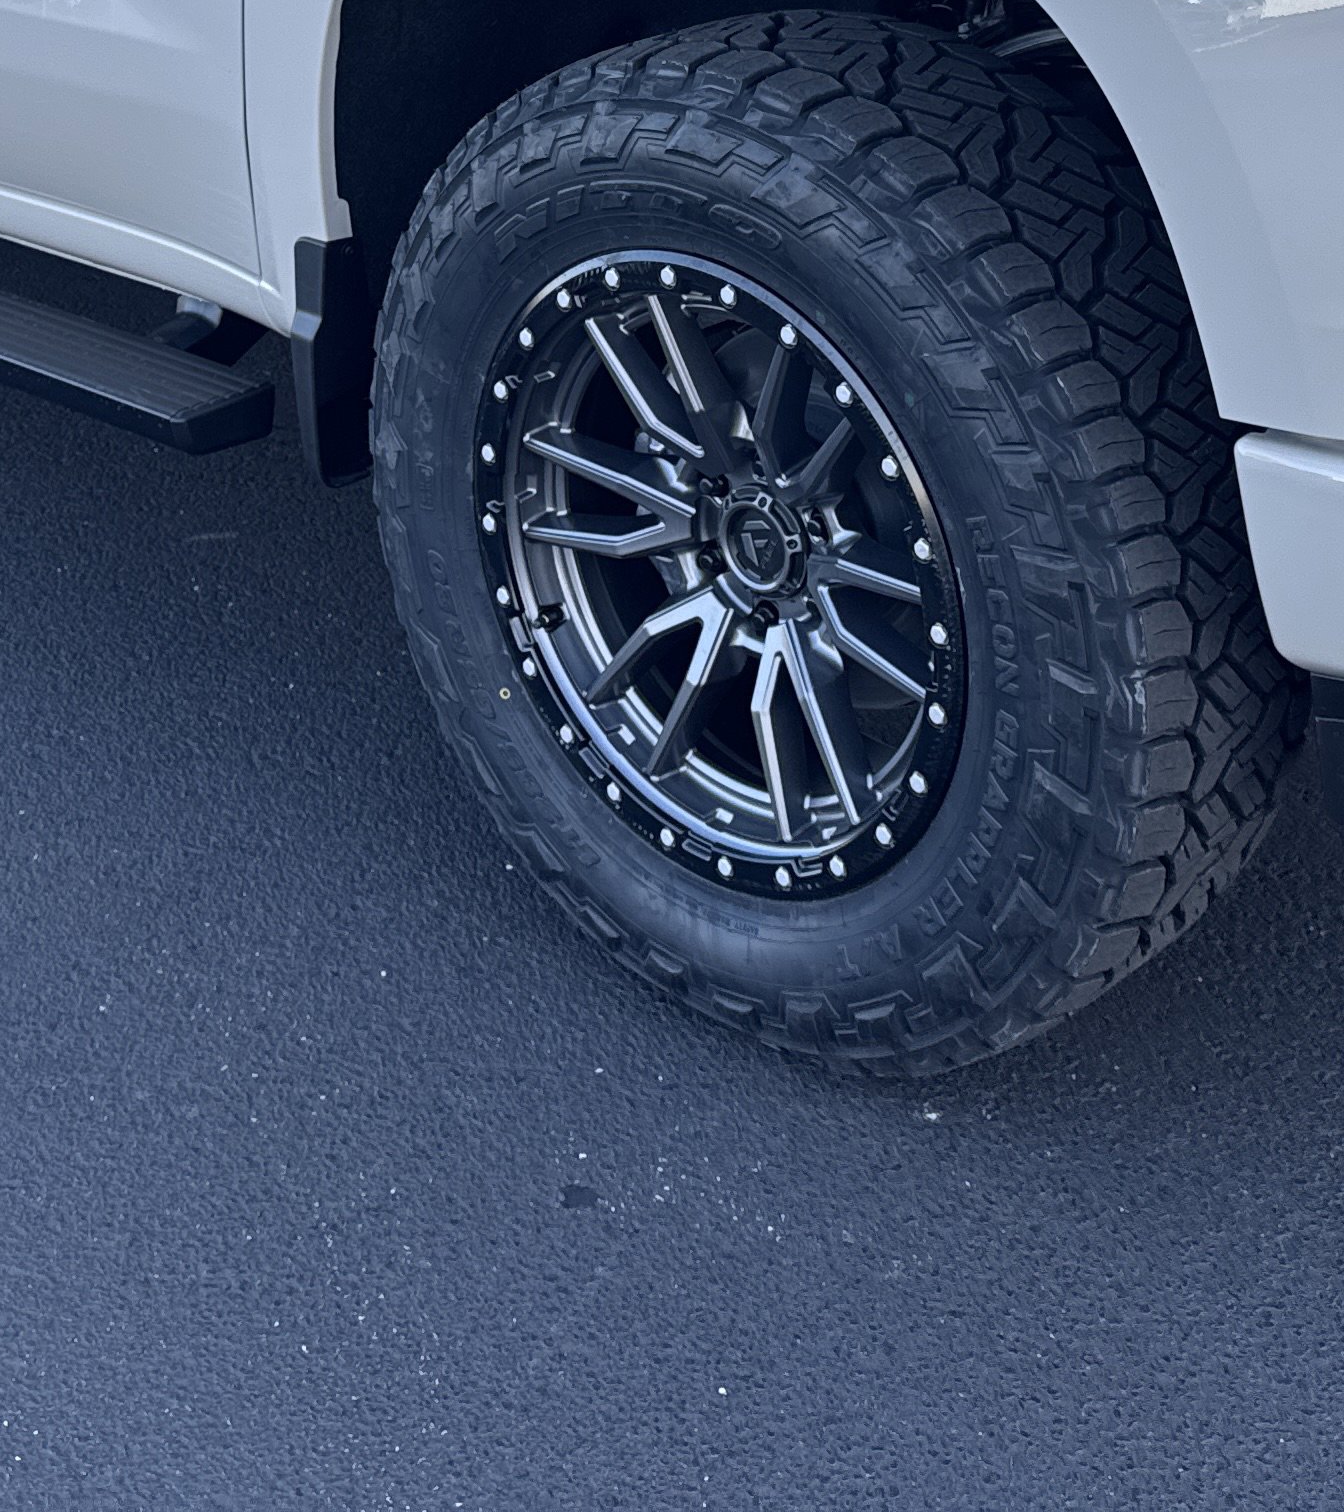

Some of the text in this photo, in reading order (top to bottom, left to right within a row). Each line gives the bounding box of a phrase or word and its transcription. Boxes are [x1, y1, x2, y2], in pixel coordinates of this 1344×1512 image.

[493, 179, 783, 265] NITTO
[964, 515, 1021, 697] RECON
[911, 708, 1020, 937] GRAPPLER
